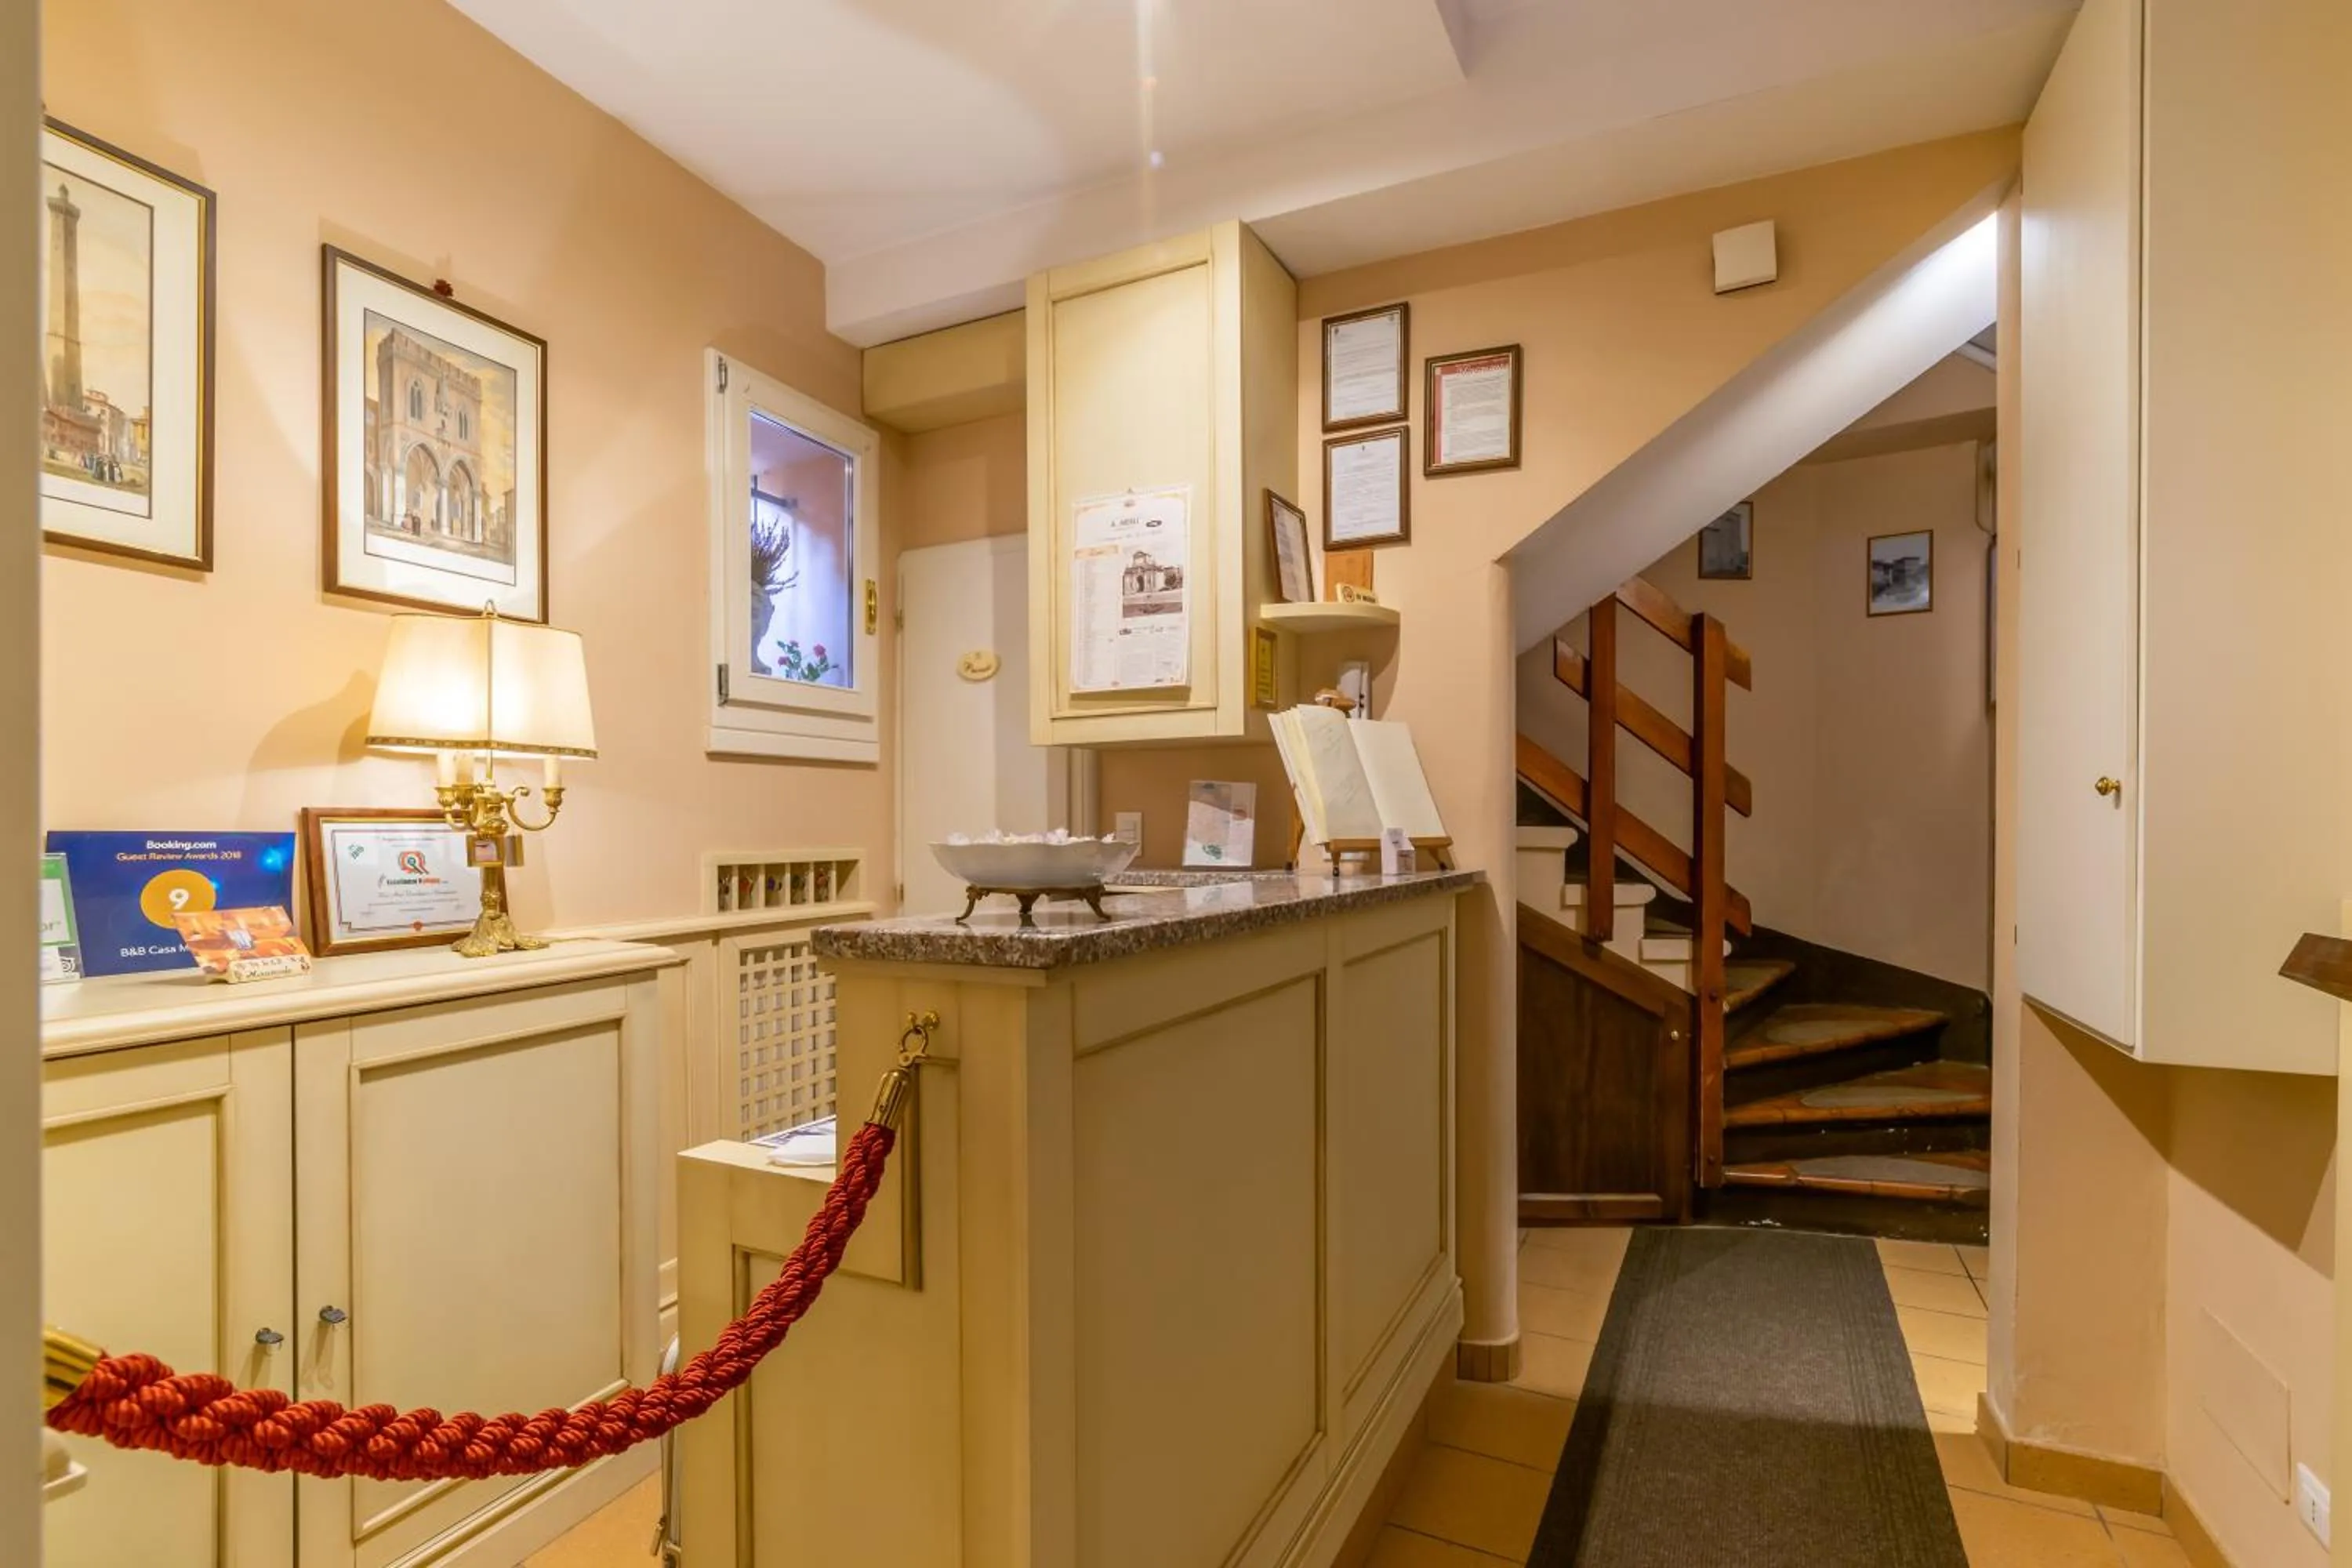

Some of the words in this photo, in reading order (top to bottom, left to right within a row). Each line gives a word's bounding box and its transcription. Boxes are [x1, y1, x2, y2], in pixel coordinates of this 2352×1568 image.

[146, 840, 217, 850] Booking.com
[116, 852, 147, 861] Guest
[169, 888, 189, 909] 9
[120, 947, 147, 957] B&B
[148, 945, 176, 954] Casa
[179, 943, 191, 953] M
